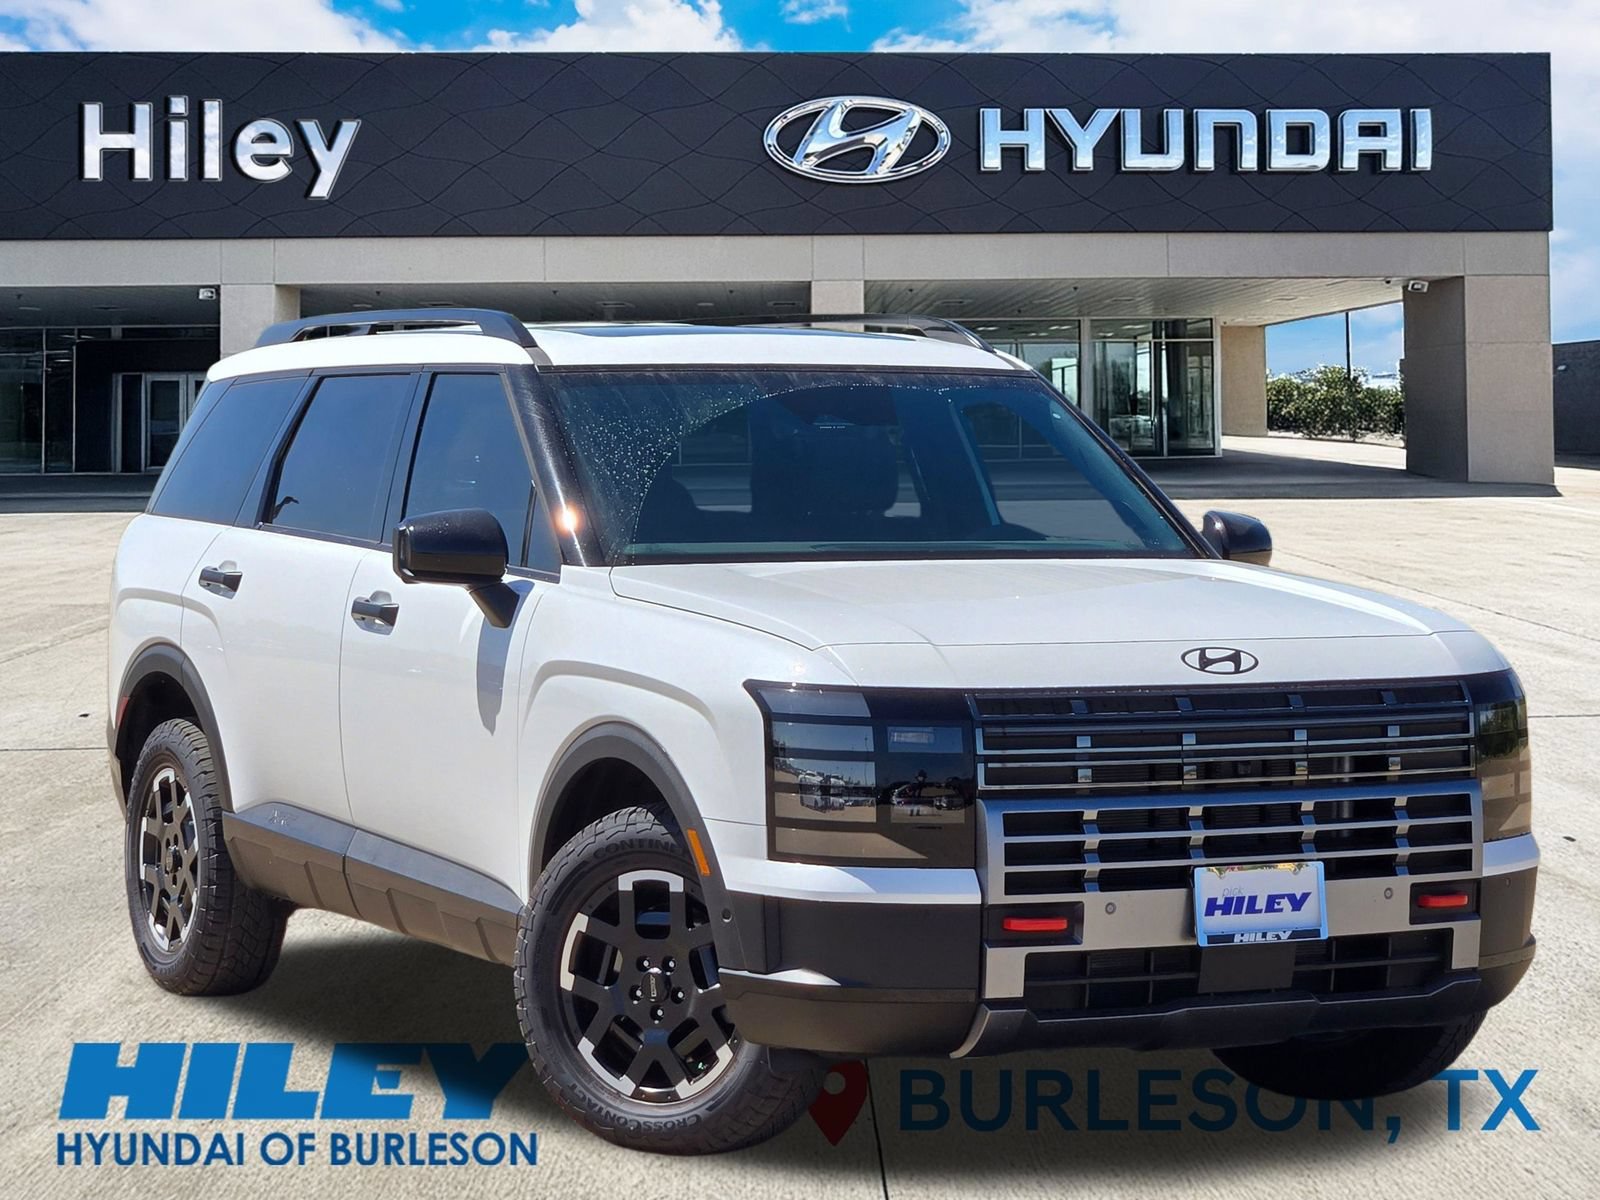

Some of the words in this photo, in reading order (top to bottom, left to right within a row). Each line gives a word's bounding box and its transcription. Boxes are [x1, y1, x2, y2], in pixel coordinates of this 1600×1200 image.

[80, 95, 362, 199] Hiley
[979, 107, 1434, 172] HYUNDAI
[1204, 892, 1312, 917] HILEY
[1233, 931, 1292, 943] HILEY
